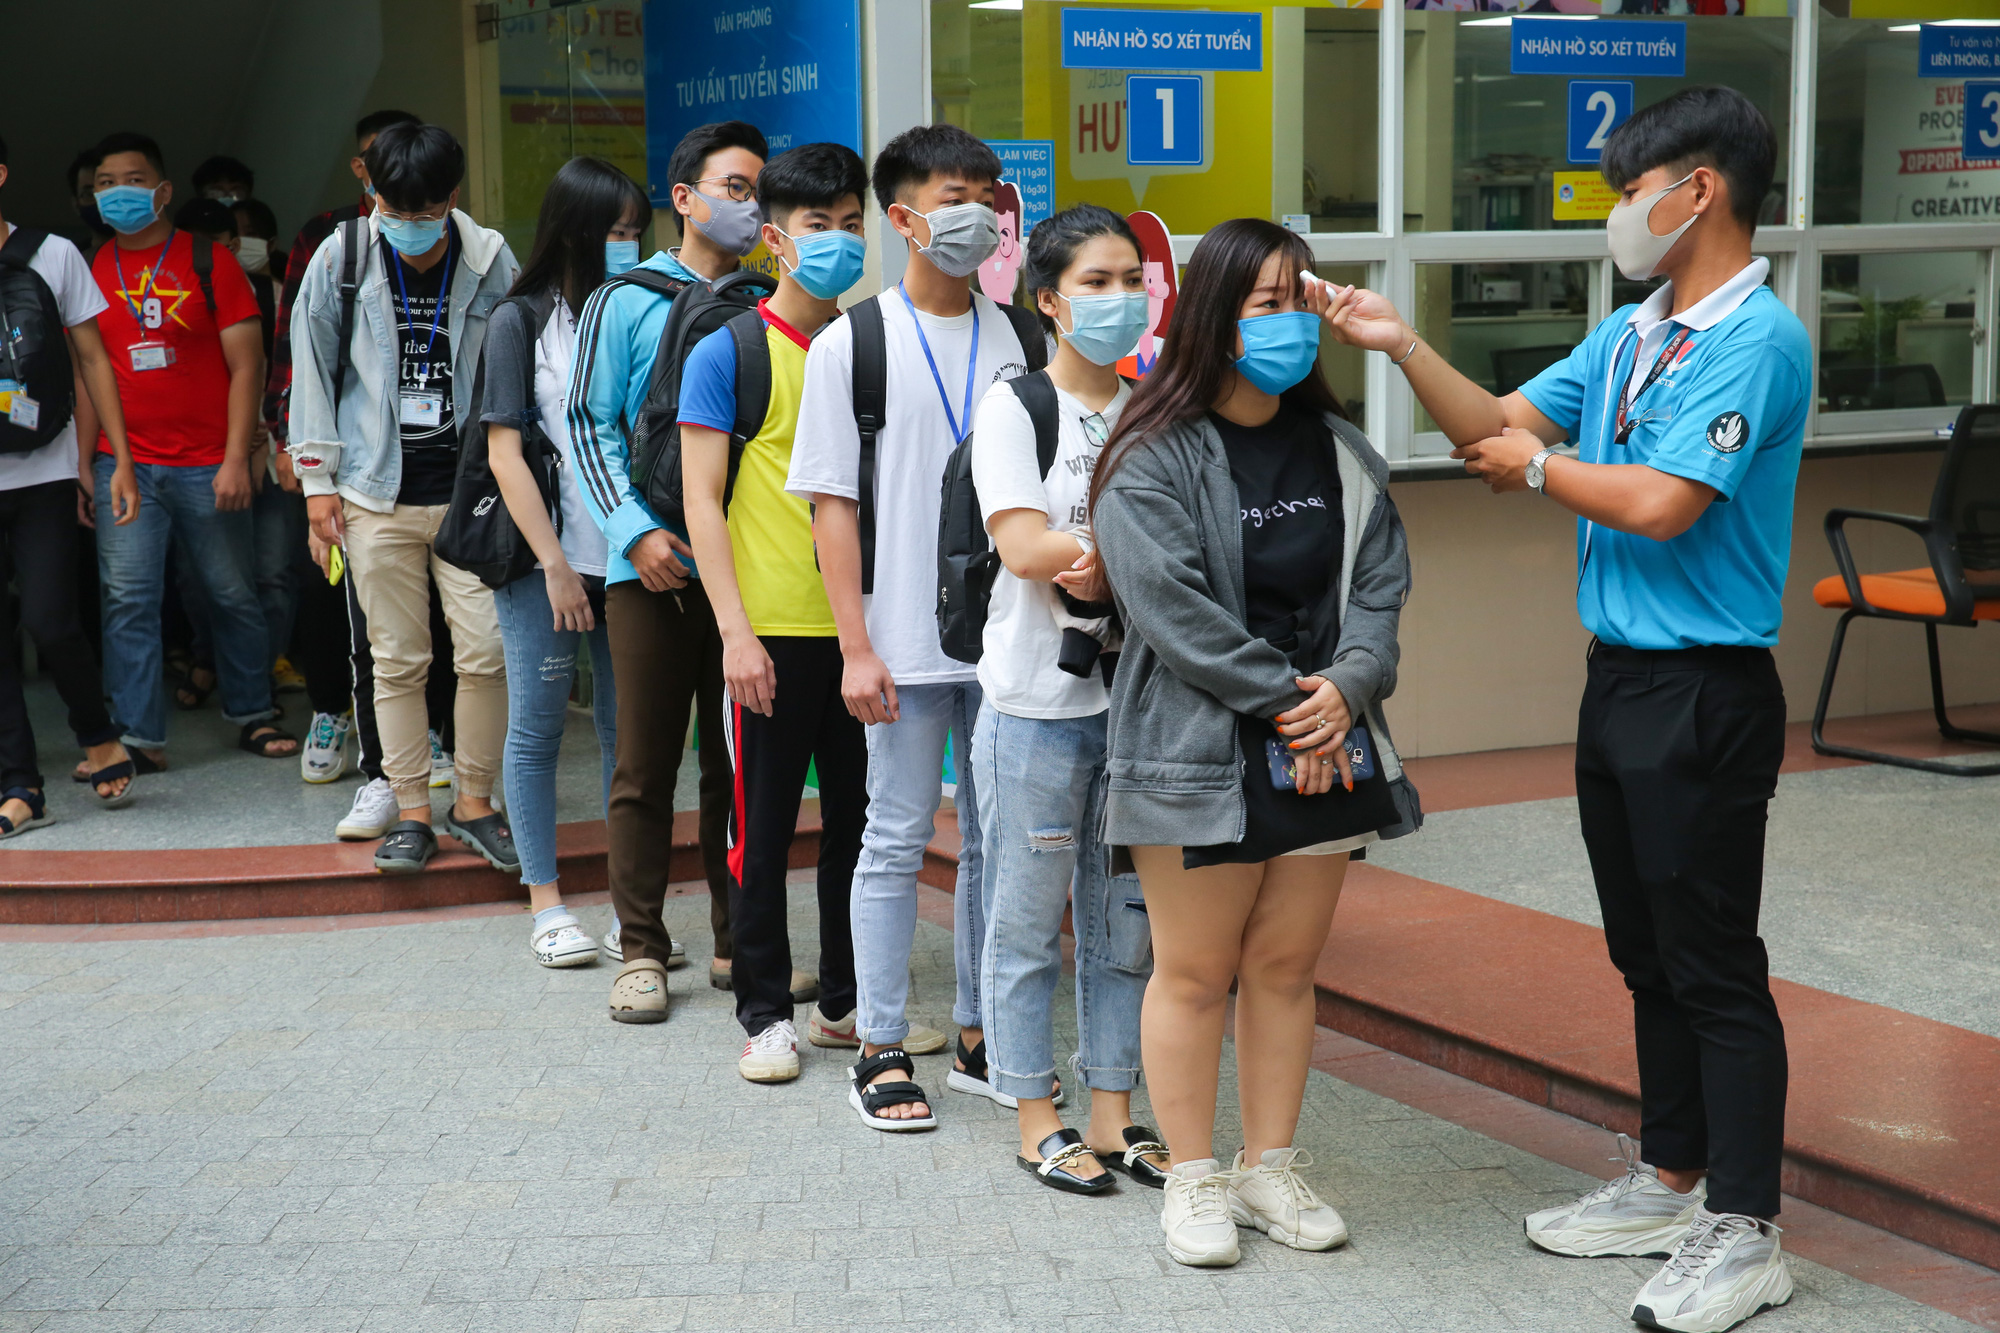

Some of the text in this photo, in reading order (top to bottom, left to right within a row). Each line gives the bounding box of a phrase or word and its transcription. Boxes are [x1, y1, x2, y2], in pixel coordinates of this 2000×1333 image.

[714, 5, 772, 34] VĂN PHÒNG
[1074, 27, 1251, 50] NHẬN HỒ SƠ XÉT TUYỂN
[1521, 35, 1676, 57] NHẬN HỒ SƠ XÉT TUYỂN
[1931, 51, 1951, 66] LIÊN
[1953, 51, 1992, 68] THÔNG,
[676, 55, 818, 108] TƯ VẤN TUYỂN SINH
[1935, 84, 1964, 106] EVE
[1079, 100, 1127, 153] HU
[1156, 88, 1174, 149] 1
[1585, 90, 1616, 149] 2
[1919, 109, 1964, 130] PROB
[1979, 91, 2000, 148] 3
[997, 149, 1047, 161] LÀM VIỆC
[1022, 167, 1047, 179] 11g30
[1022, 185, 1047, 196] 16g30
[1911, 195, 2000, 217] CREATIVE
[143, 298, 162, 329] 9
[404, 339, 428, 354] the
[1068, 505, 1088, 525] 19
